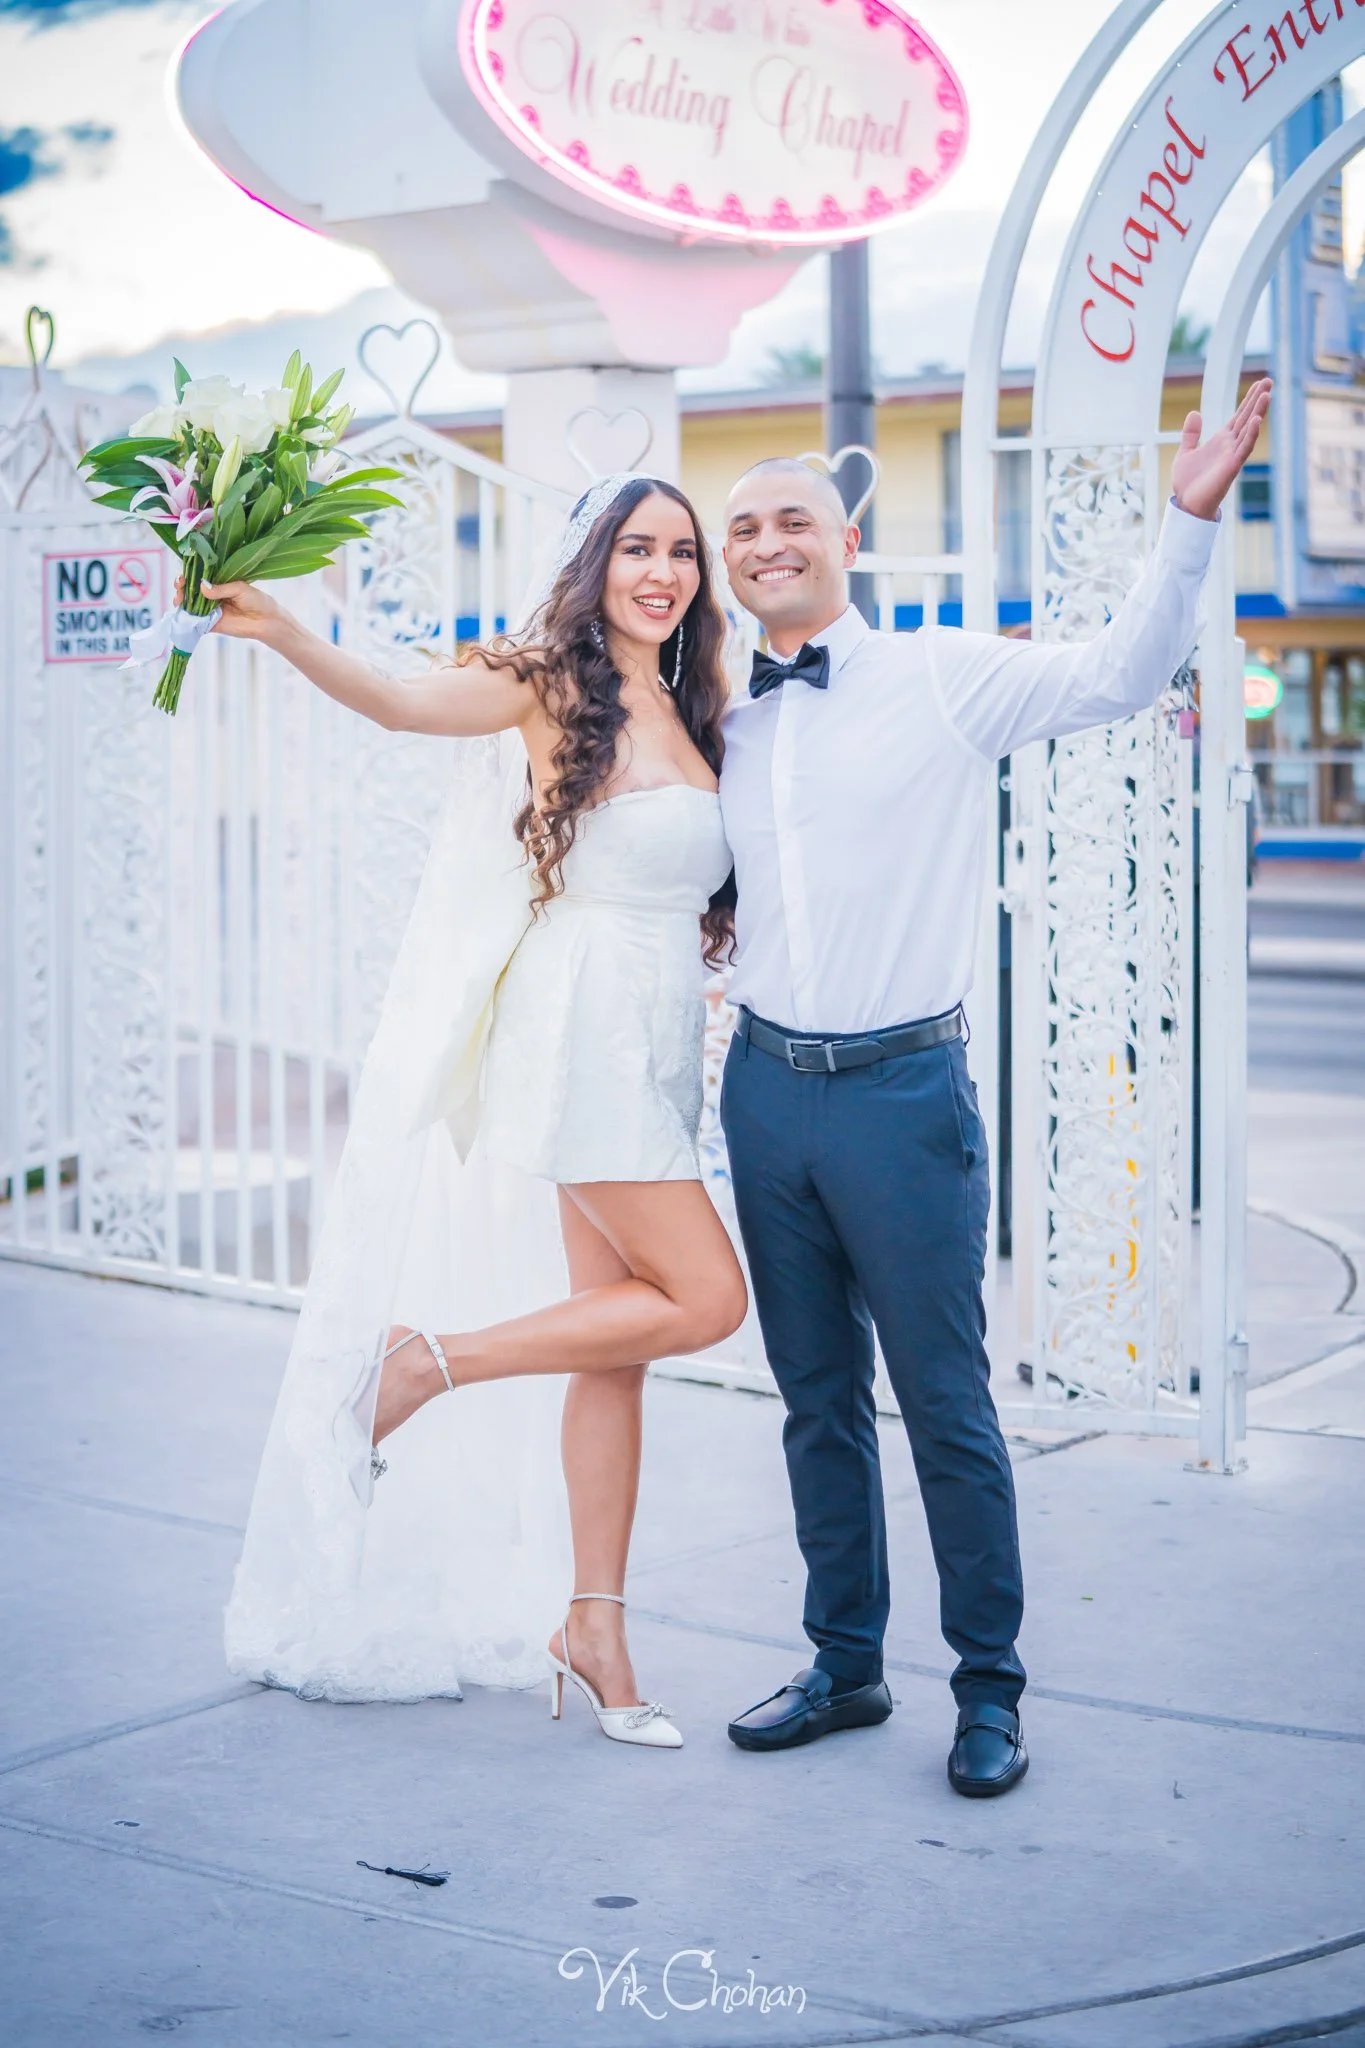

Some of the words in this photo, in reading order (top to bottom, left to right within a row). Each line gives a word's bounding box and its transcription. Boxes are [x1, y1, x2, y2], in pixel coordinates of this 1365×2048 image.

[515, 12, 731, 158] Wedding
[751, 54, 910, 180] Chapel
[1080, 96, 1206, 363] Chapel
[1213, 0, 1365, 102] Ent
[57, 560, 107, 602] NO
[56, 608, 151, 634] SMOKING
[56, 640, 70, 655] IN
[77, 637, 107, 654] THIS
[112, 637, 130, 652] AR
